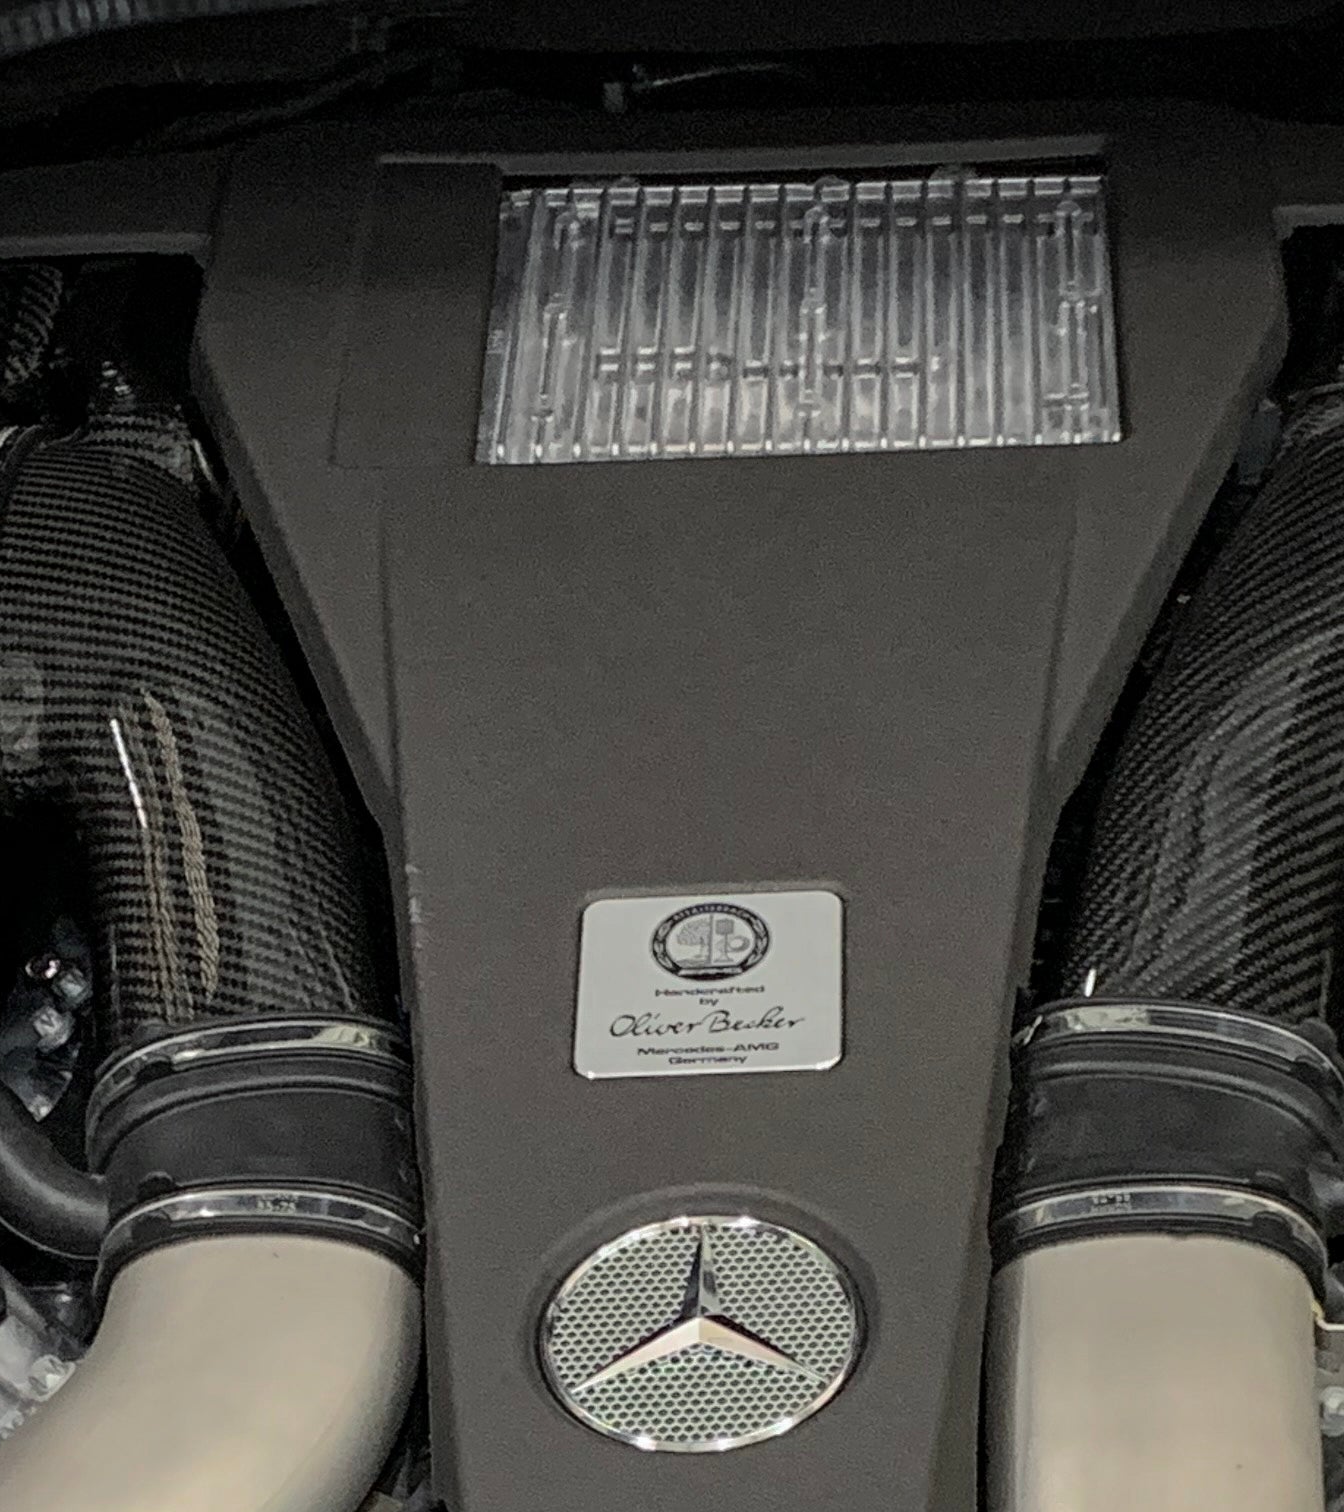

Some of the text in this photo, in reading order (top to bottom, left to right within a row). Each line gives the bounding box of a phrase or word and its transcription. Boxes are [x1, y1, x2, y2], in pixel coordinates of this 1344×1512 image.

[655, 984, 765, 998] Handcrafted
[699, 997, 719, 1008] by
[609, 1006, 806, 1038] Oliver Becker
[637, 1042, 780, 1056] Mercedes-AMG
[668, 1055, 748, 1066] Germany
